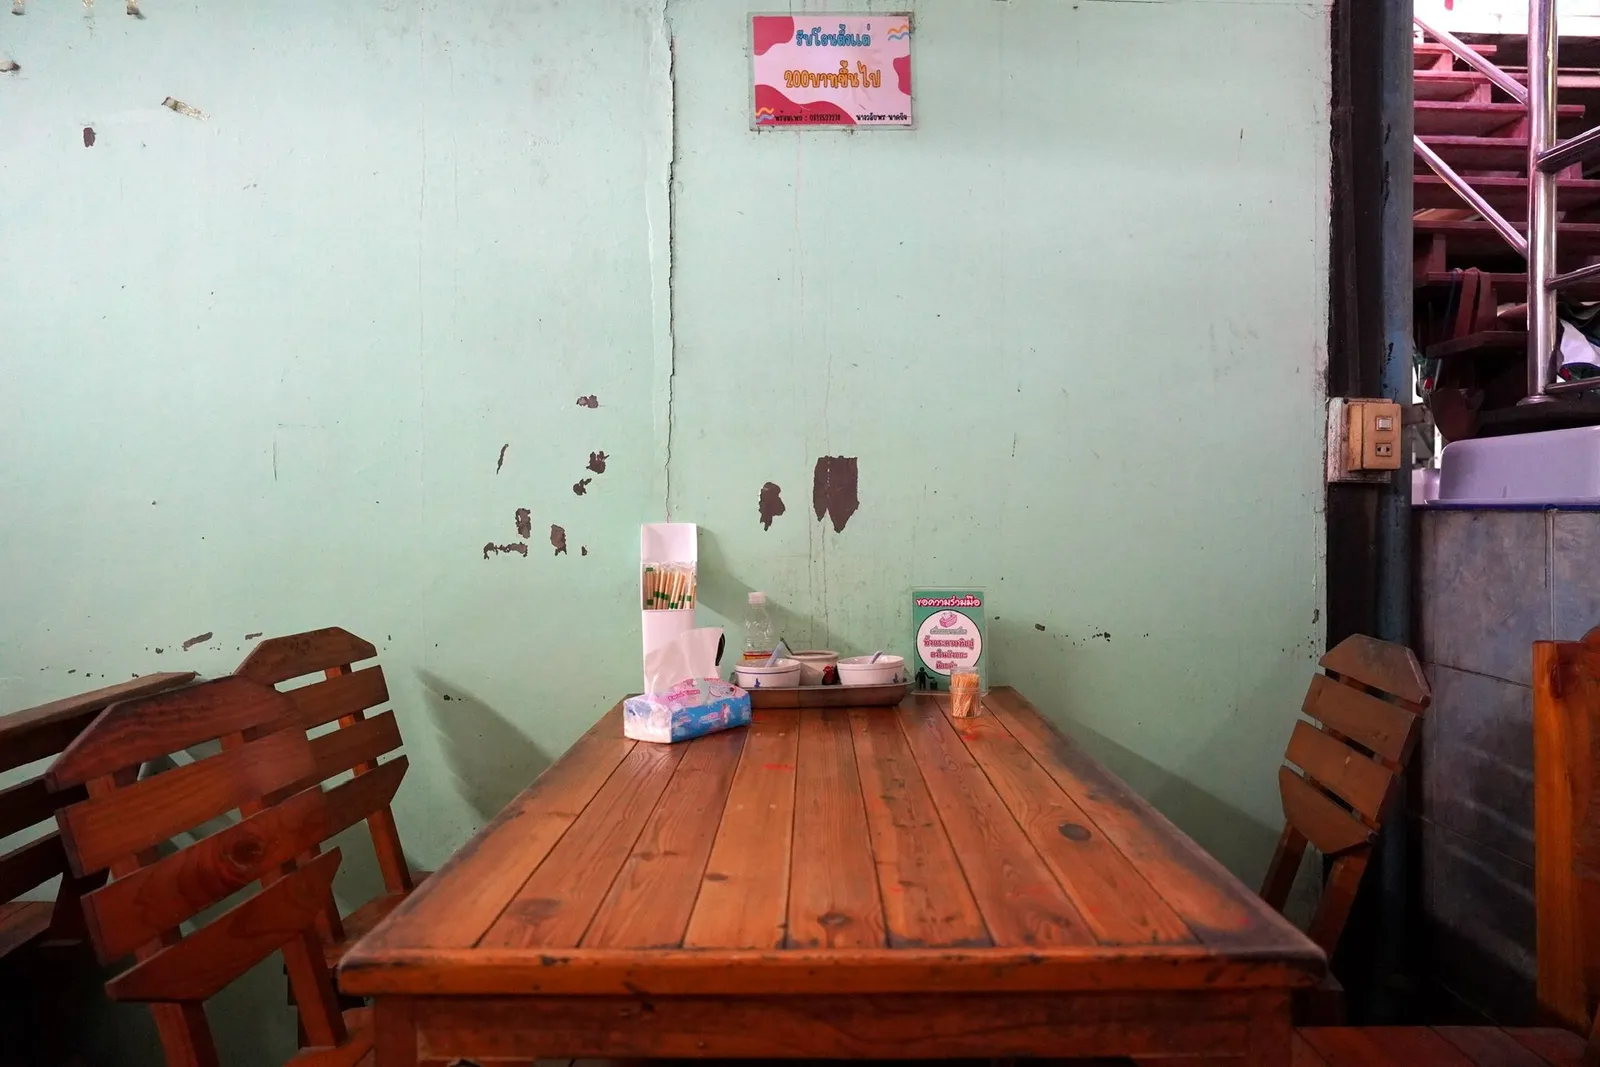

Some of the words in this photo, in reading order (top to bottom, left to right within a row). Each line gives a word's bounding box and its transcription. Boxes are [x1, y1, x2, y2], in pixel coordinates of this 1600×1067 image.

[796, 23, 871, 47] รับโอนตั้งแต่
[915, 595, 982, 608] ขอความร่วมมือ
